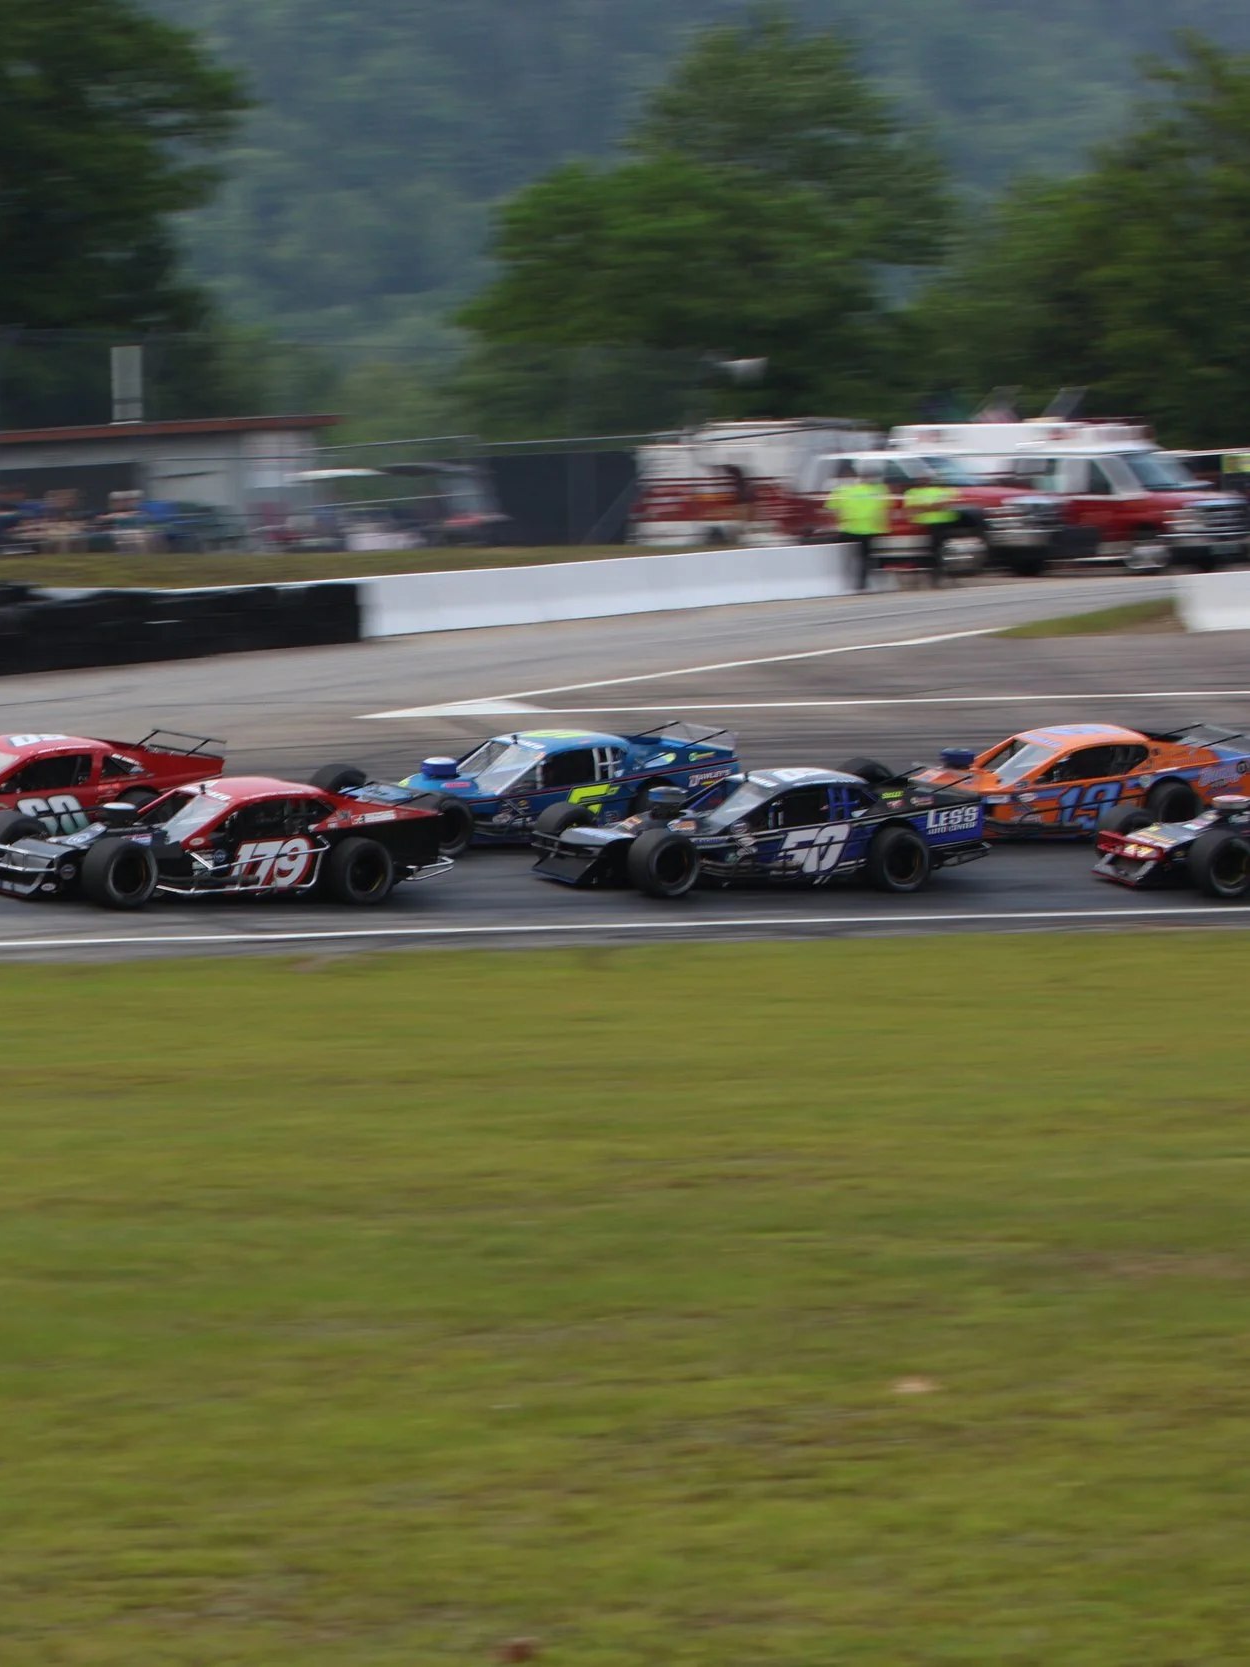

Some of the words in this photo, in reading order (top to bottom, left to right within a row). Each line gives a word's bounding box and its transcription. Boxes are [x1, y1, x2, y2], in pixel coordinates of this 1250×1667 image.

[925, 805, 980, 829] LES'S
[926, 826, 948, 836] AUTO
[948, 821, 979, 833] CENTER
[777, 823, 850, 874] 50
